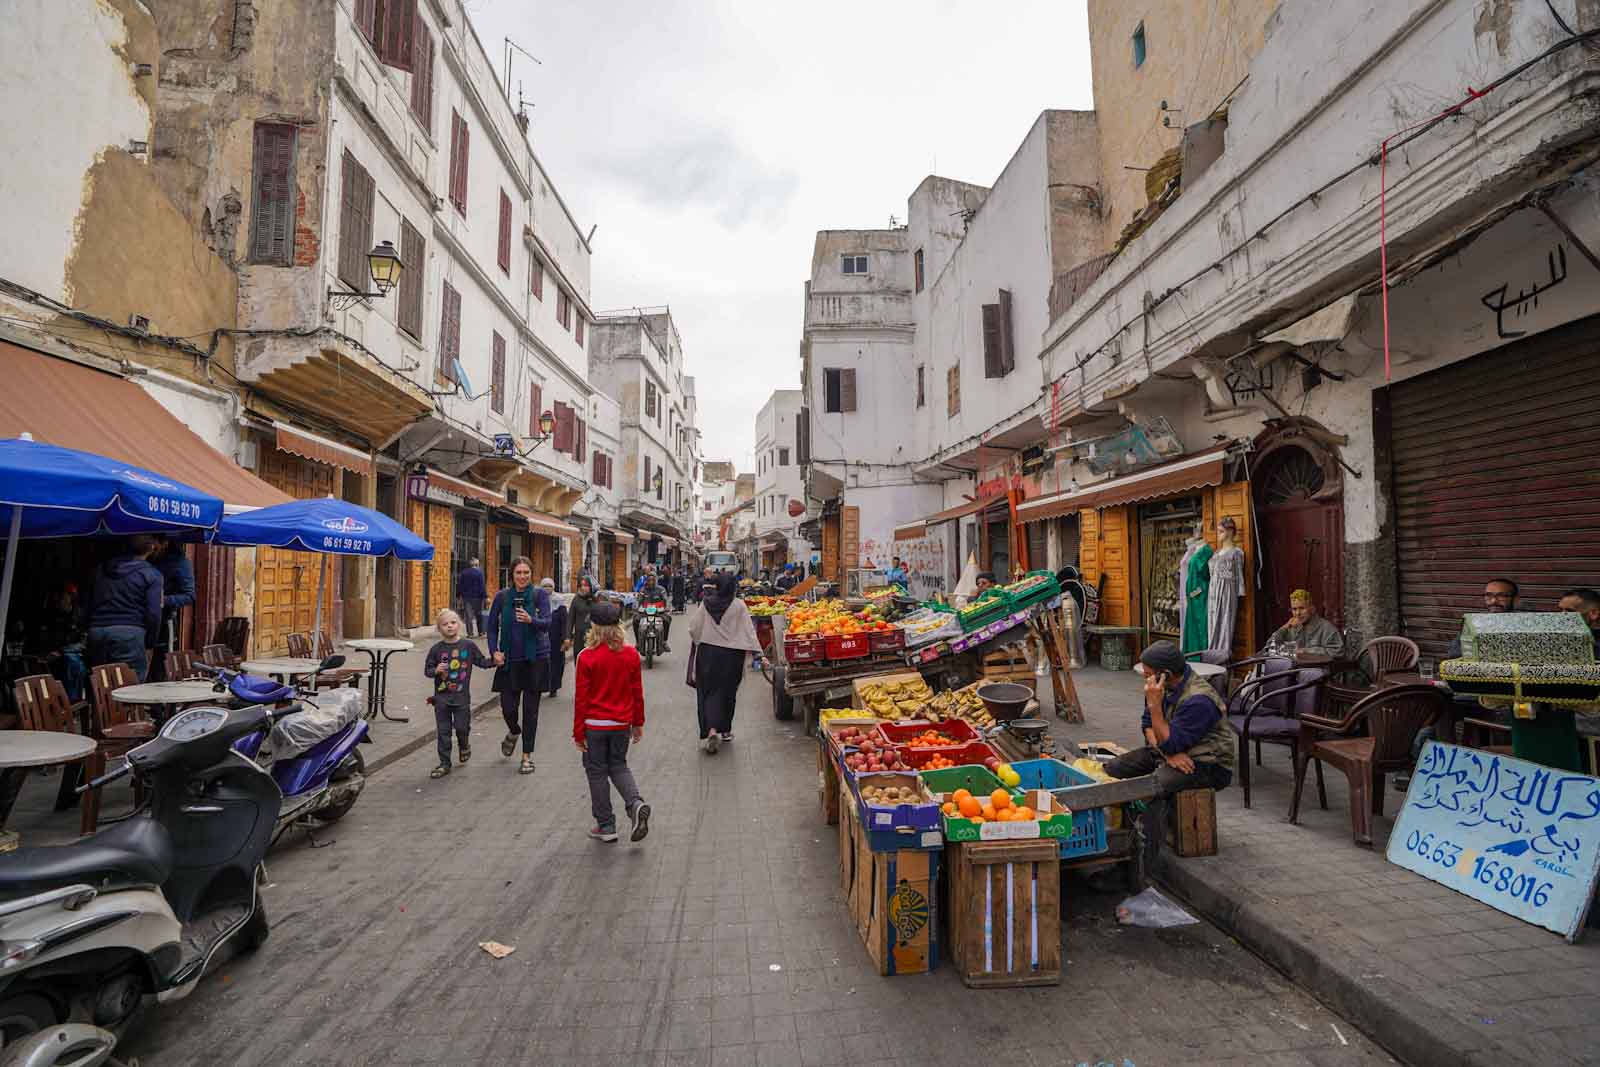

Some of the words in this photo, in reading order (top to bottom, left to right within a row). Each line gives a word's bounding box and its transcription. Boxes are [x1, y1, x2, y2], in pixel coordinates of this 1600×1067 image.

[148, 496, 159, 512] 06
[160, 498, 169, 513] 61
[181, 502, 190, 517] 92
[191, 504, 200, 519] 70
[362, 540, 372, 551] 70
[1530, 824, 1581, 862] بيع
[1406, 829, 1463, 868] 06.63
[1472, 856, 1553, 907] 168016
